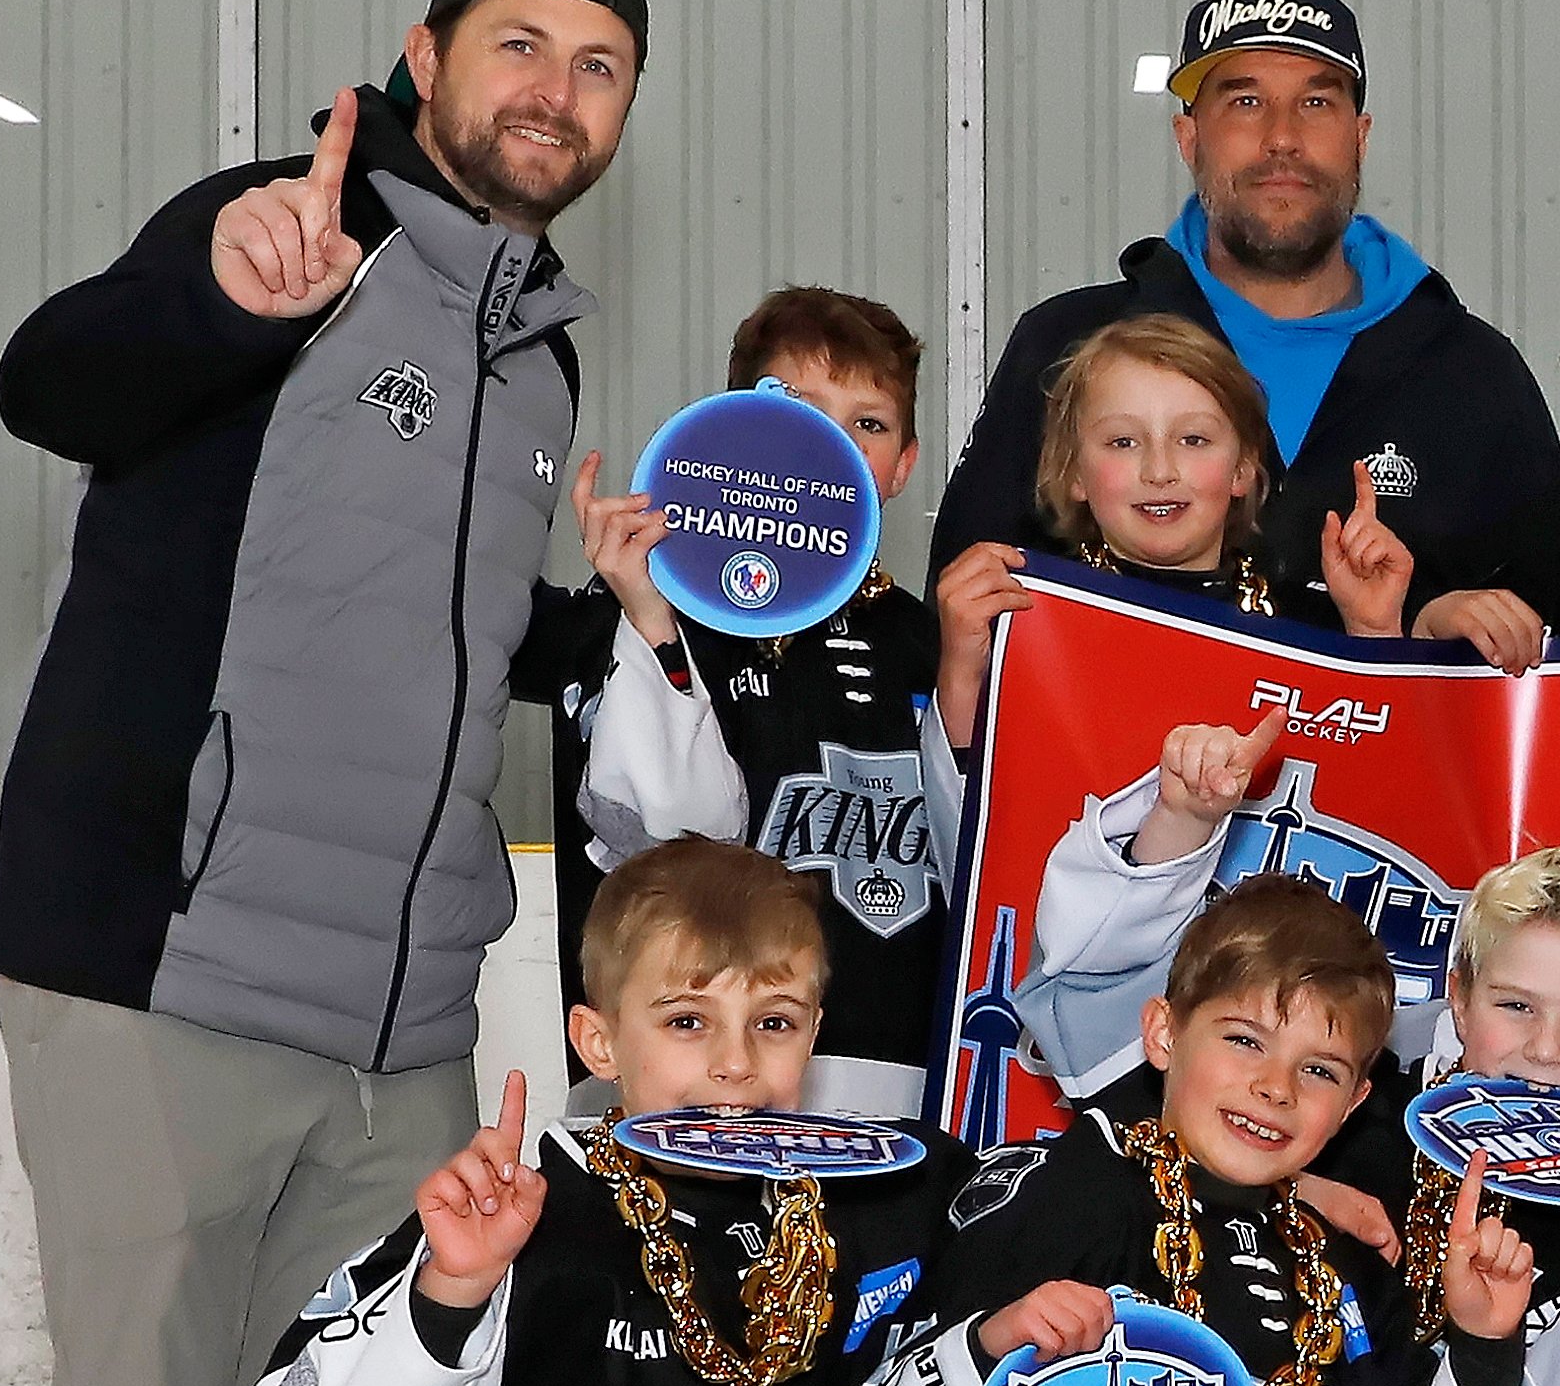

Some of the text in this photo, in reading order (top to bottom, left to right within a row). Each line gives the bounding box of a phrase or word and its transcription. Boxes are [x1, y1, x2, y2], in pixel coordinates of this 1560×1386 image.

[665, 459, 856, 502] HOCKEY HALL OF FAME
[720, 488, 798, 514] TORONTO
[664, 504, 849, 556] CHAMPIONS
[1250, 679, 1390, 733] PLAY
[1287, 720, 1362, 746] OCKEY
[847, 769, 893, 793] Young
[777, 786, 938, 870] KING
